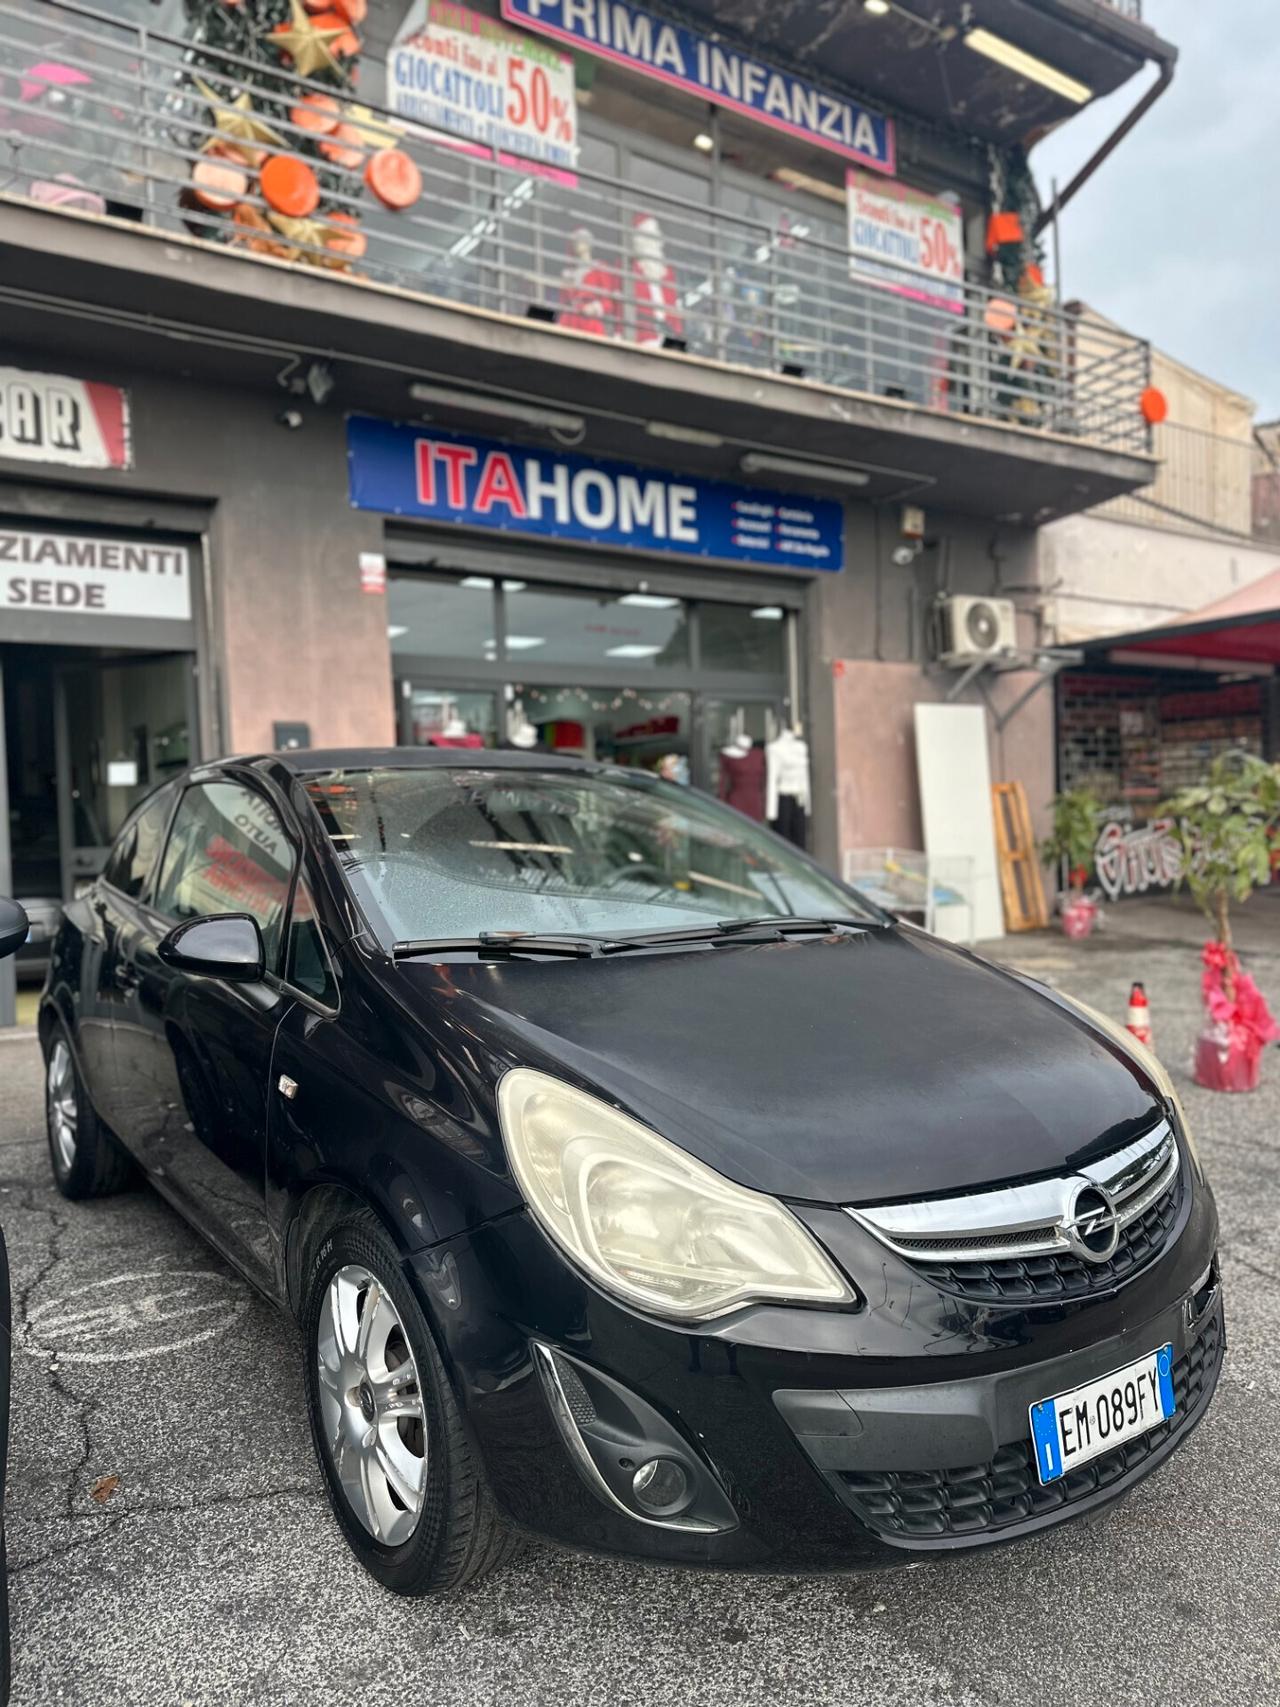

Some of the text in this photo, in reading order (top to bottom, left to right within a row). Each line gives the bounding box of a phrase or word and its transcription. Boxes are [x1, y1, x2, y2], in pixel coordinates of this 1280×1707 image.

[395, 51, 504, 120] GIOCATTOLI
[507, 56, 573, 143] 50%
[699, 40, 879, 157] INFANZIA
[0, 380, 83, 451] AR
[414, 438, 698, 543] ITAHOME
[8, 577, 107, 609] SEDE
